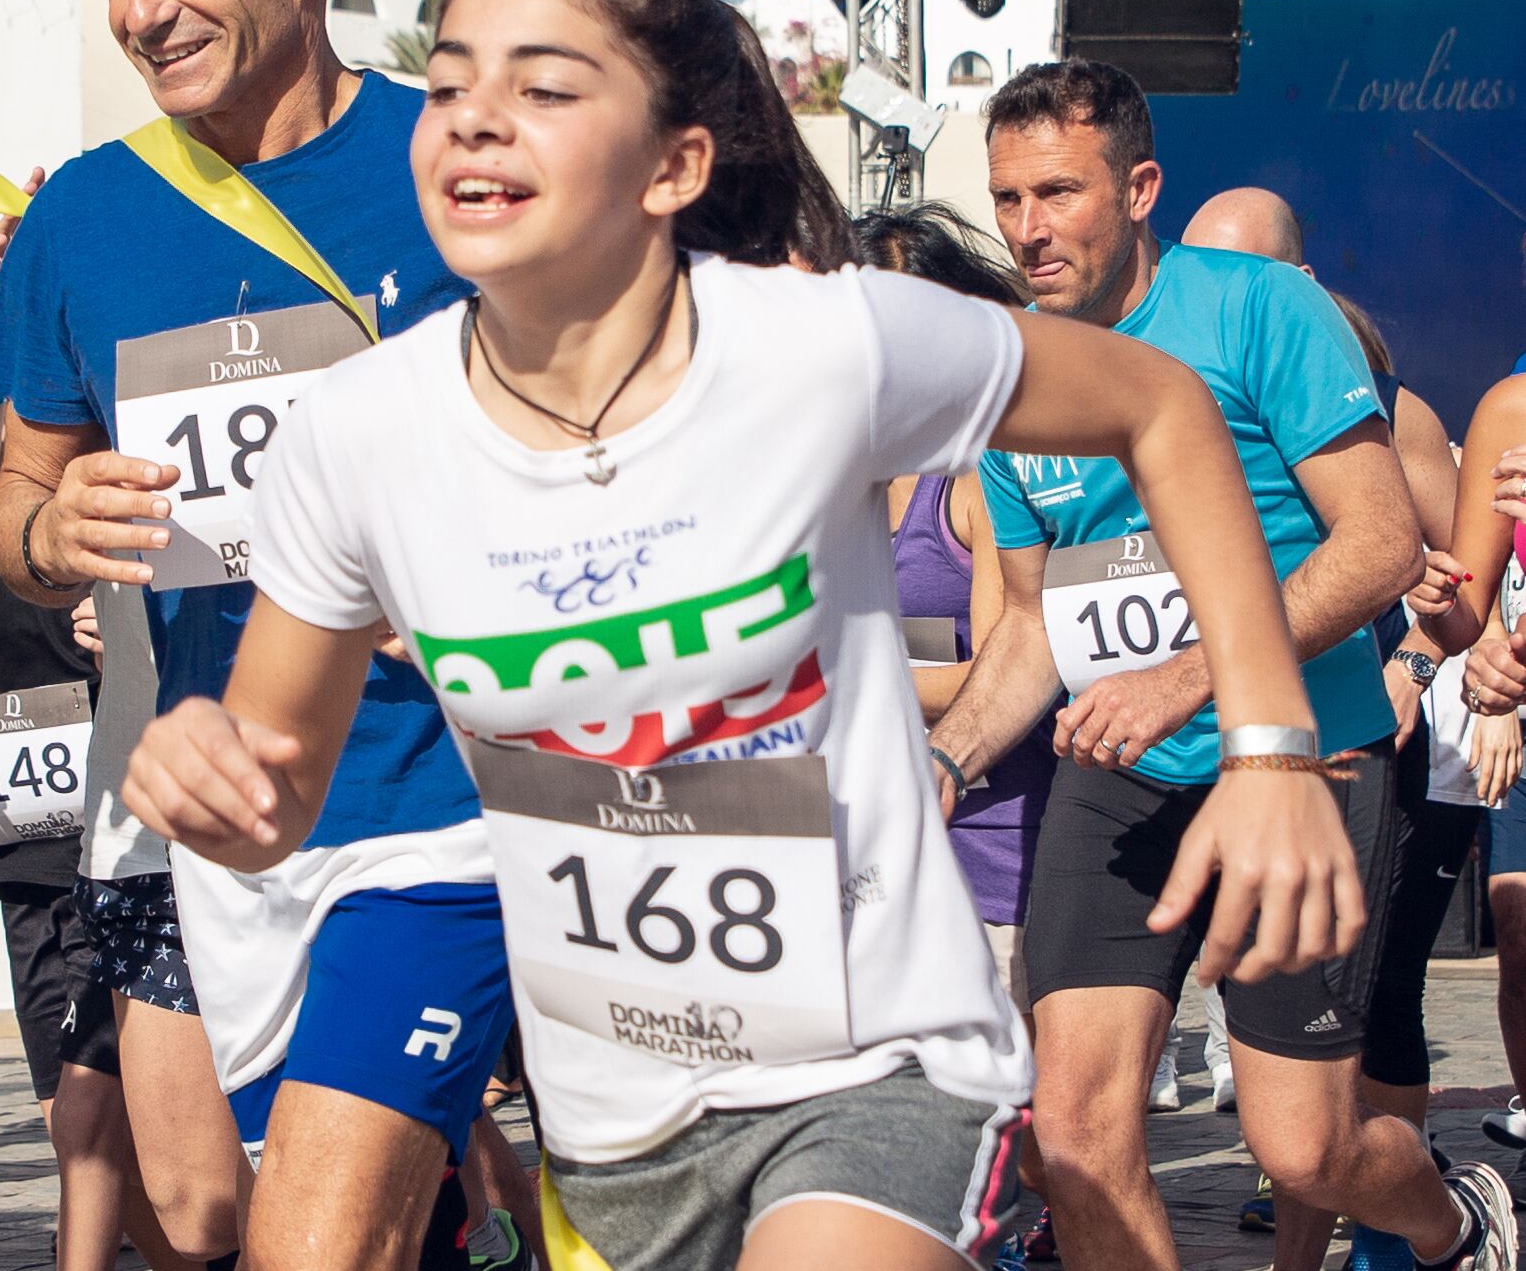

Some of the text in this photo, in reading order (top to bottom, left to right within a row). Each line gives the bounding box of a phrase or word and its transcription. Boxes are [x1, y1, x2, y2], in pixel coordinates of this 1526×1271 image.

[209, 357, 282, 383] DOMINA
[165, 399, 297, 502] 18
[488, 515, 696, 569] TORINO TRIATHLON
[1107, 561, 1157, 579] DOMINA
[1076, 588, 1202, 662] 102
[14, 815, 70, 834] DOMINA
[20, 824, 86, 840] MARATHON
[597, 803, 697, 833] DOMINA
[547, 854, 784, 973] 168
[608, 1001, 728, 1043] DOMINA
[1304, 1022, 1343, 1032] adidas
[613, 1025, 754, 1063] MARATHON
